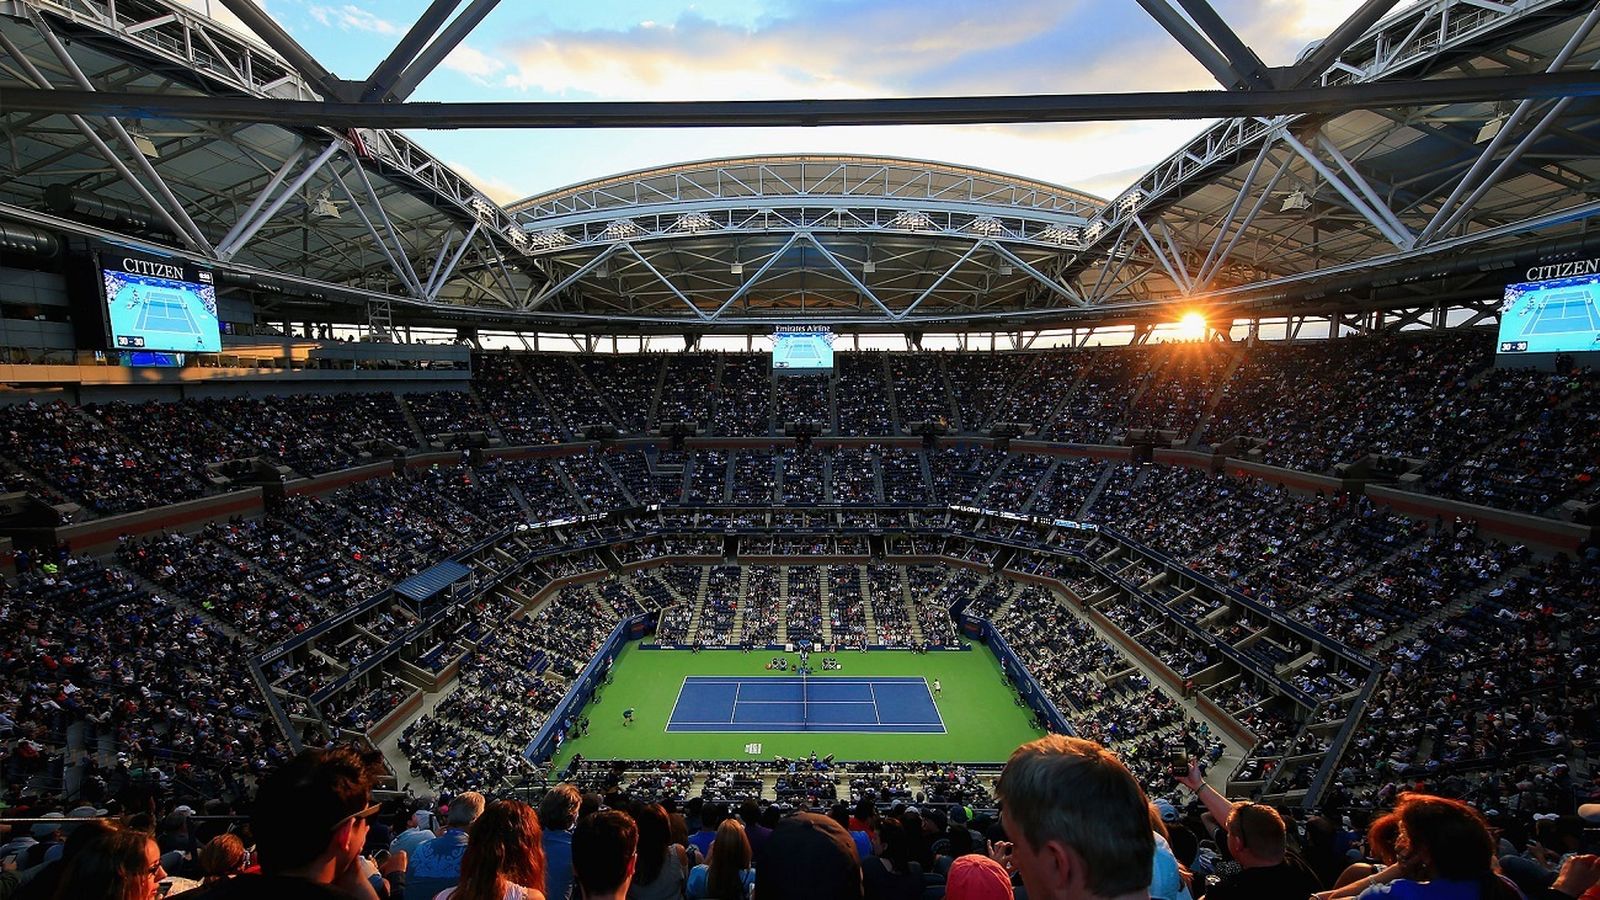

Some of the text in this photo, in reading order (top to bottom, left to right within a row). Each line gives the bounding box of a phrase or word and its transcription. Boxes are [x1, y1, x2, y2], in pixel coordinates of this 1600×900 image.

[122, 257, 184, 280] CITIZEN
[1526, 258, 1600, 281] CITIZEN
[117, 336, 129, 346] 30
